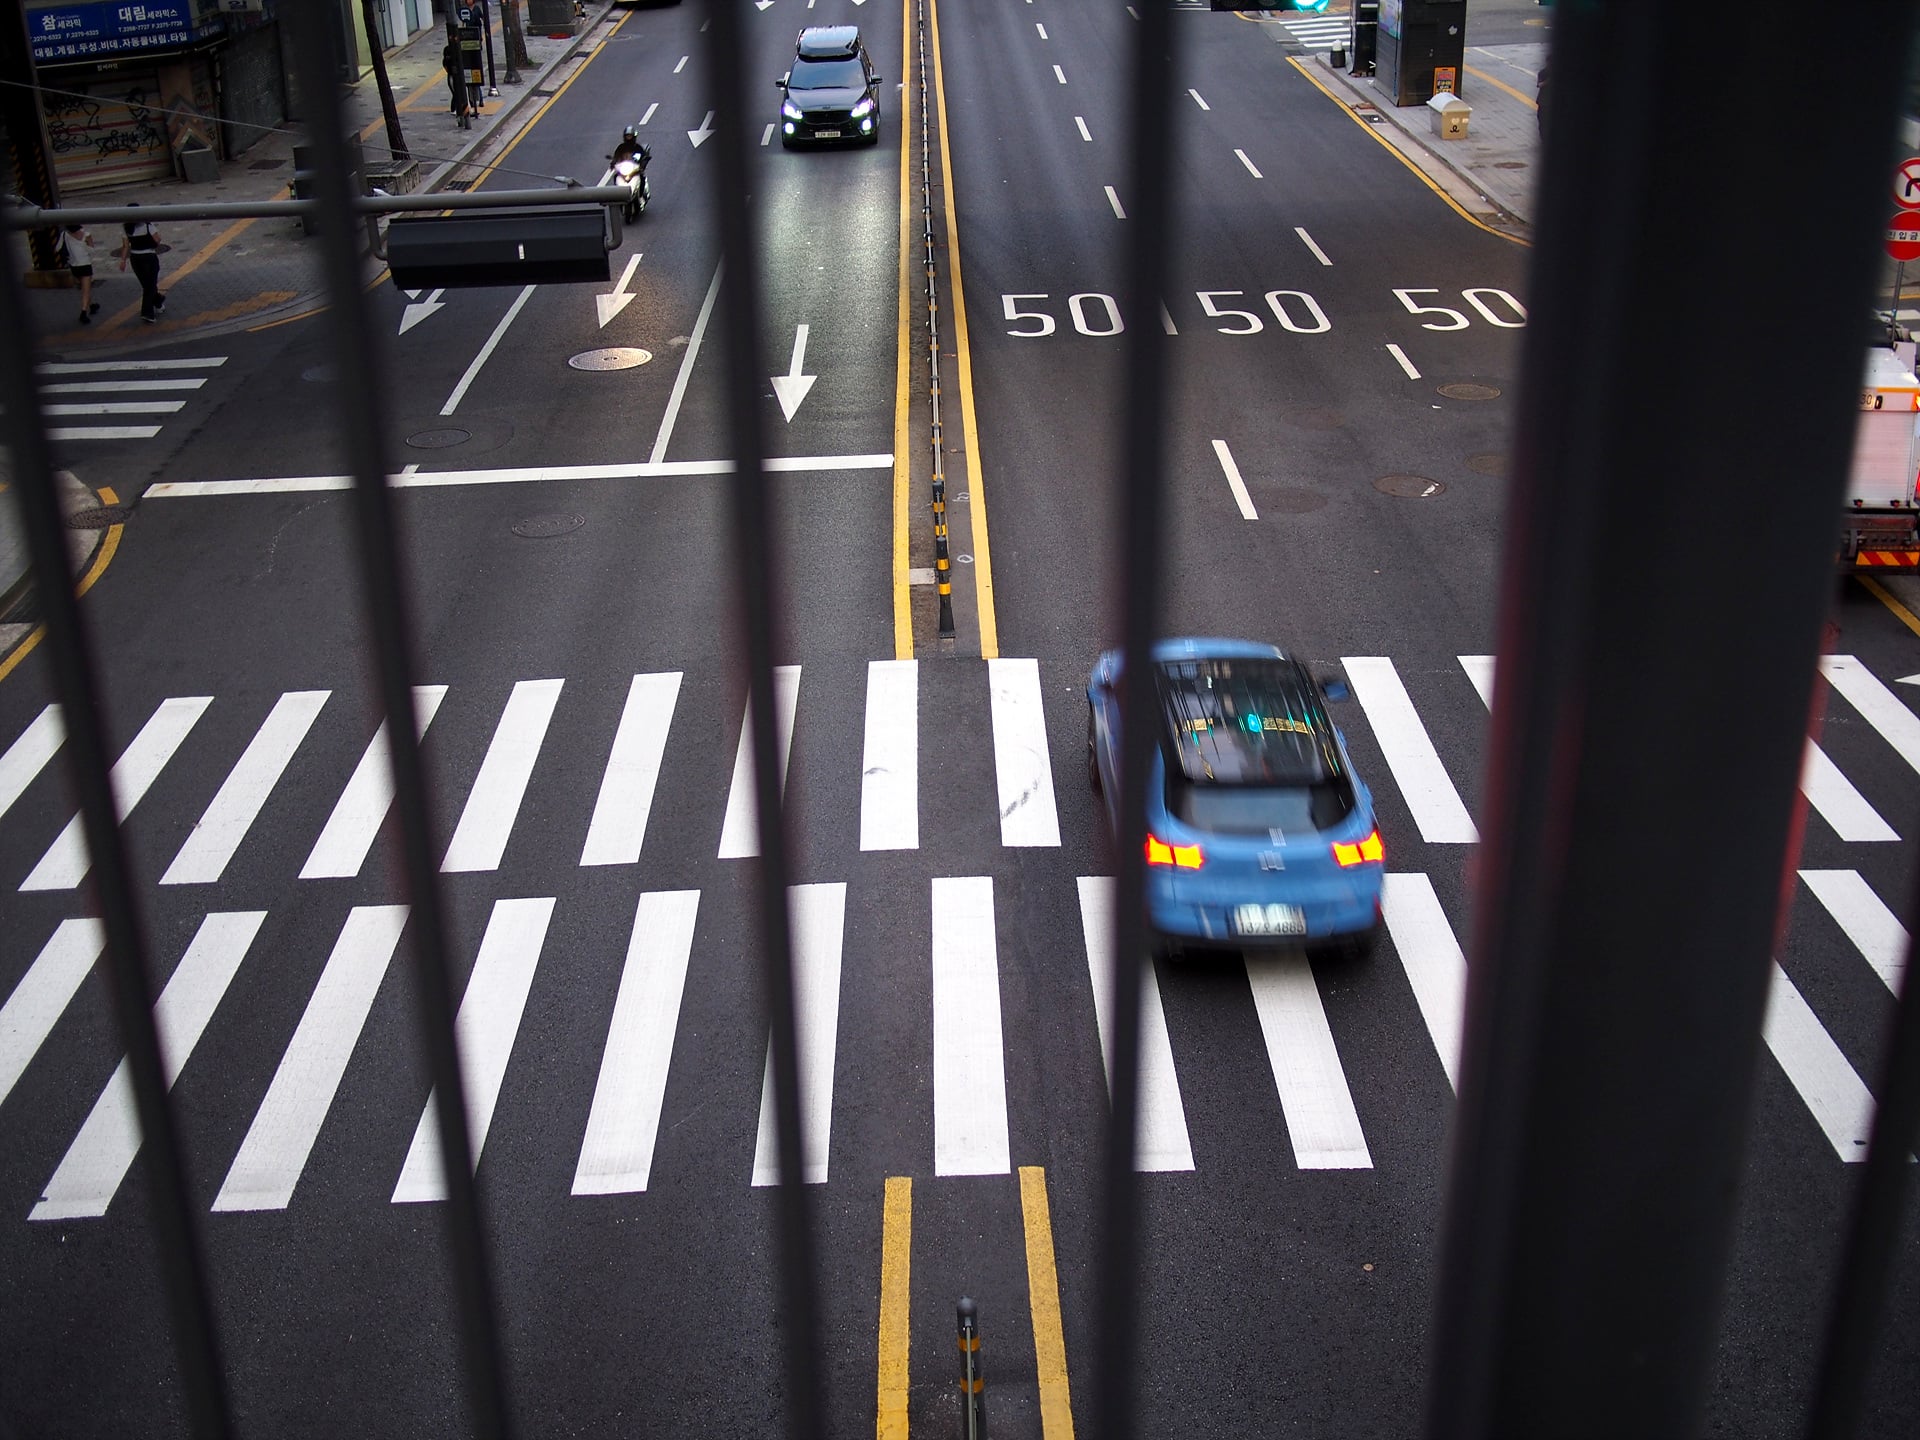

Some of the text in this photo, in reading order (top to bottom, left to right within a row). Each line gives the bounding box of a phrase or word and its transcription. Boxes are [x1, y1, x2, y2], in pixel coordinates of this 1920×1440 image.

[41, 14, 82, 31] 참 세라믹
[118, 5, 178, 22] 대림 세라믹스
[1001, 293, 1125, 338] 50
[1195, 289, 1332, 335] 50
[1391, 287, 1528, 332] 50
